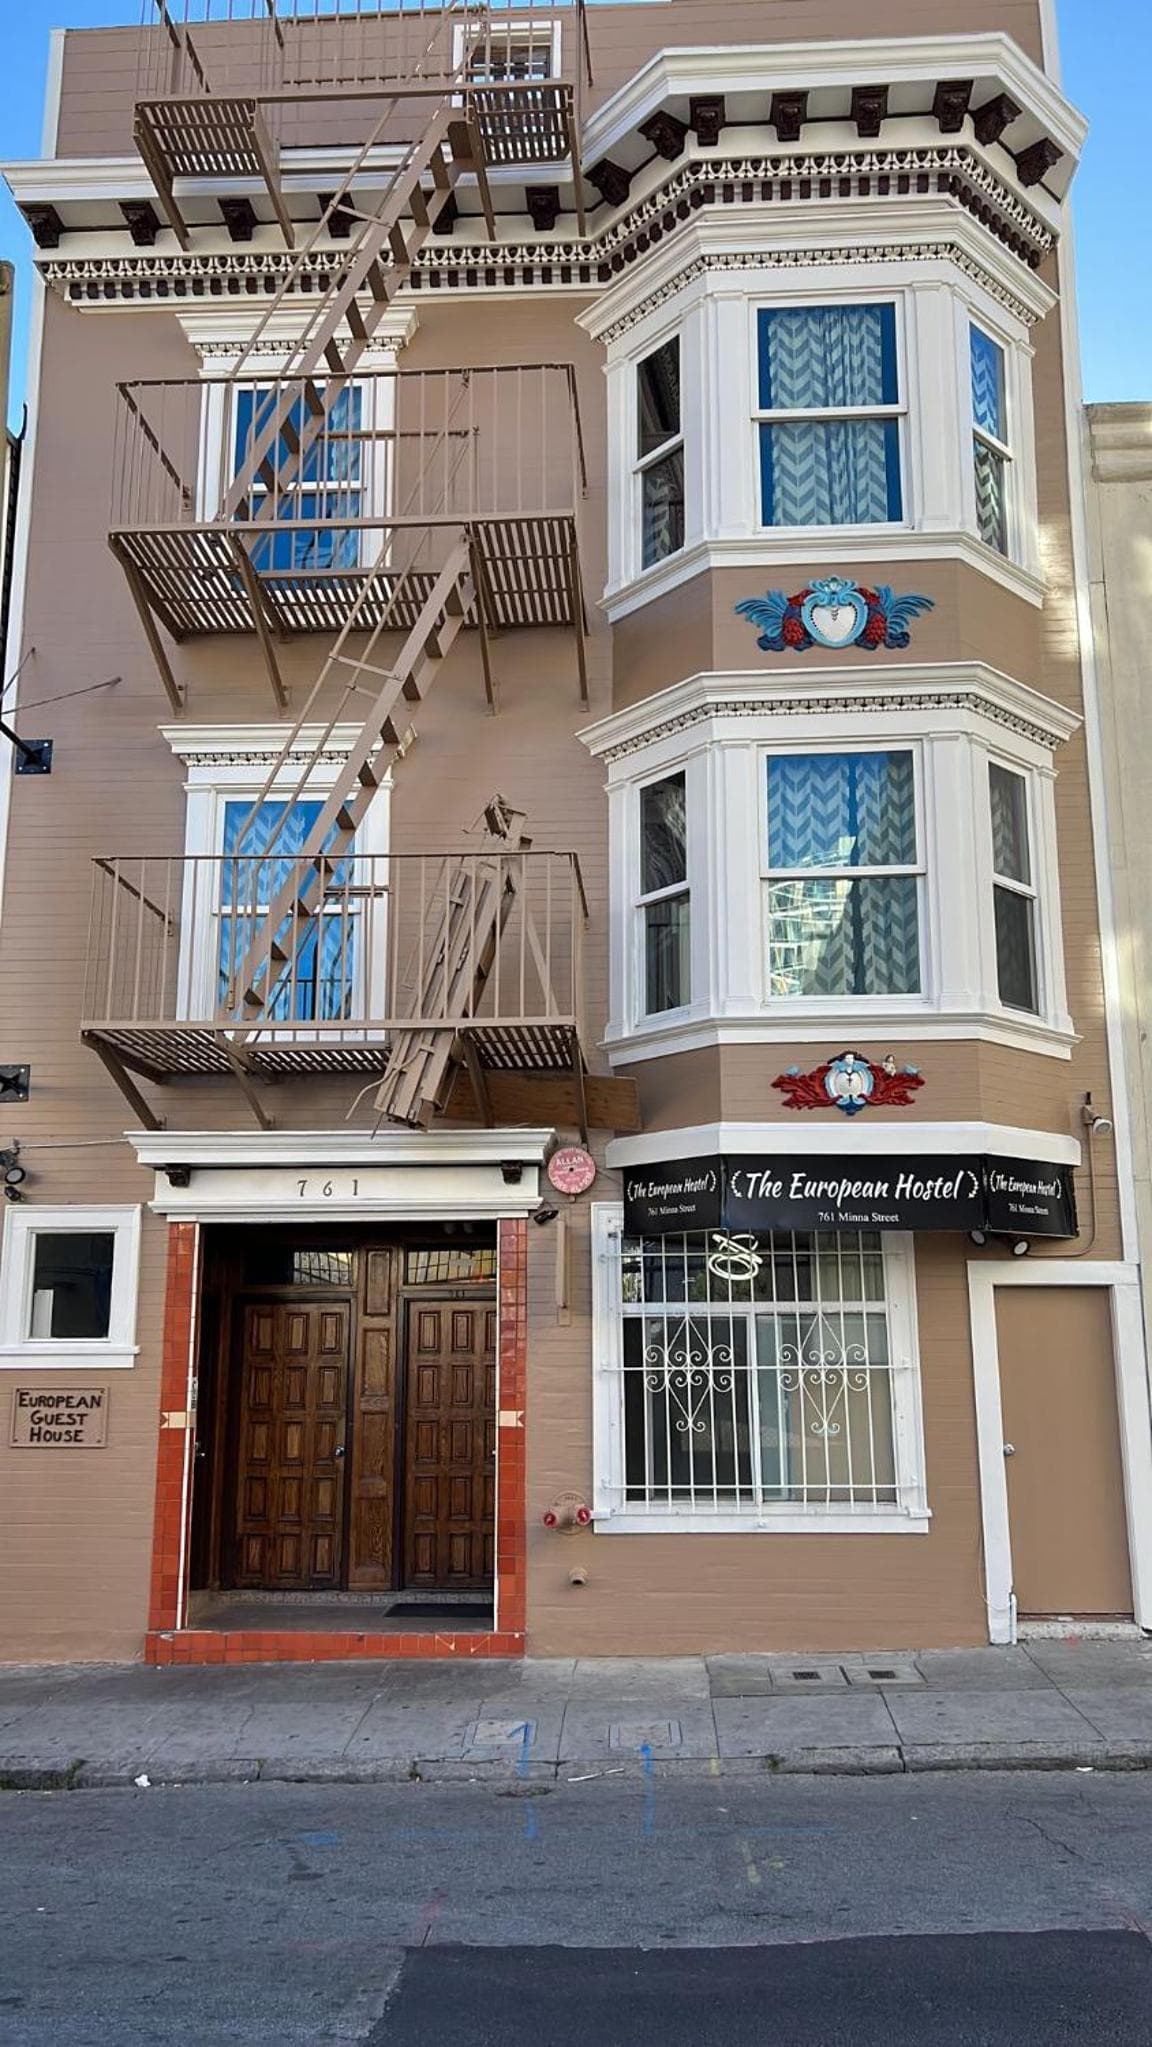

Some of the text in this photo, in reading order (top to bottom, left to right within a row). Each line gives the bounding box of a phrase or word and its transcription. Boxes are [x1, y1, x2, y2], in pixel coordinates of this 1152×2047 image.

[297, 1179, 359, 1197] 761
[633, 1173, 710, 1200] The European Hostel
[745, 1169, 965, 1209] The European Hostel
[995, 1173, 1008, 1191] The
[1008, 1175, 1037, 1198] European
[818, 1211, 900, 1222] 761 Minna Street
[18, 1392, 102, 1409] EUROPEAN
[30, 1409, 88, 1426] GUEST
[29, 1426, 84, 1442] HOUSE
